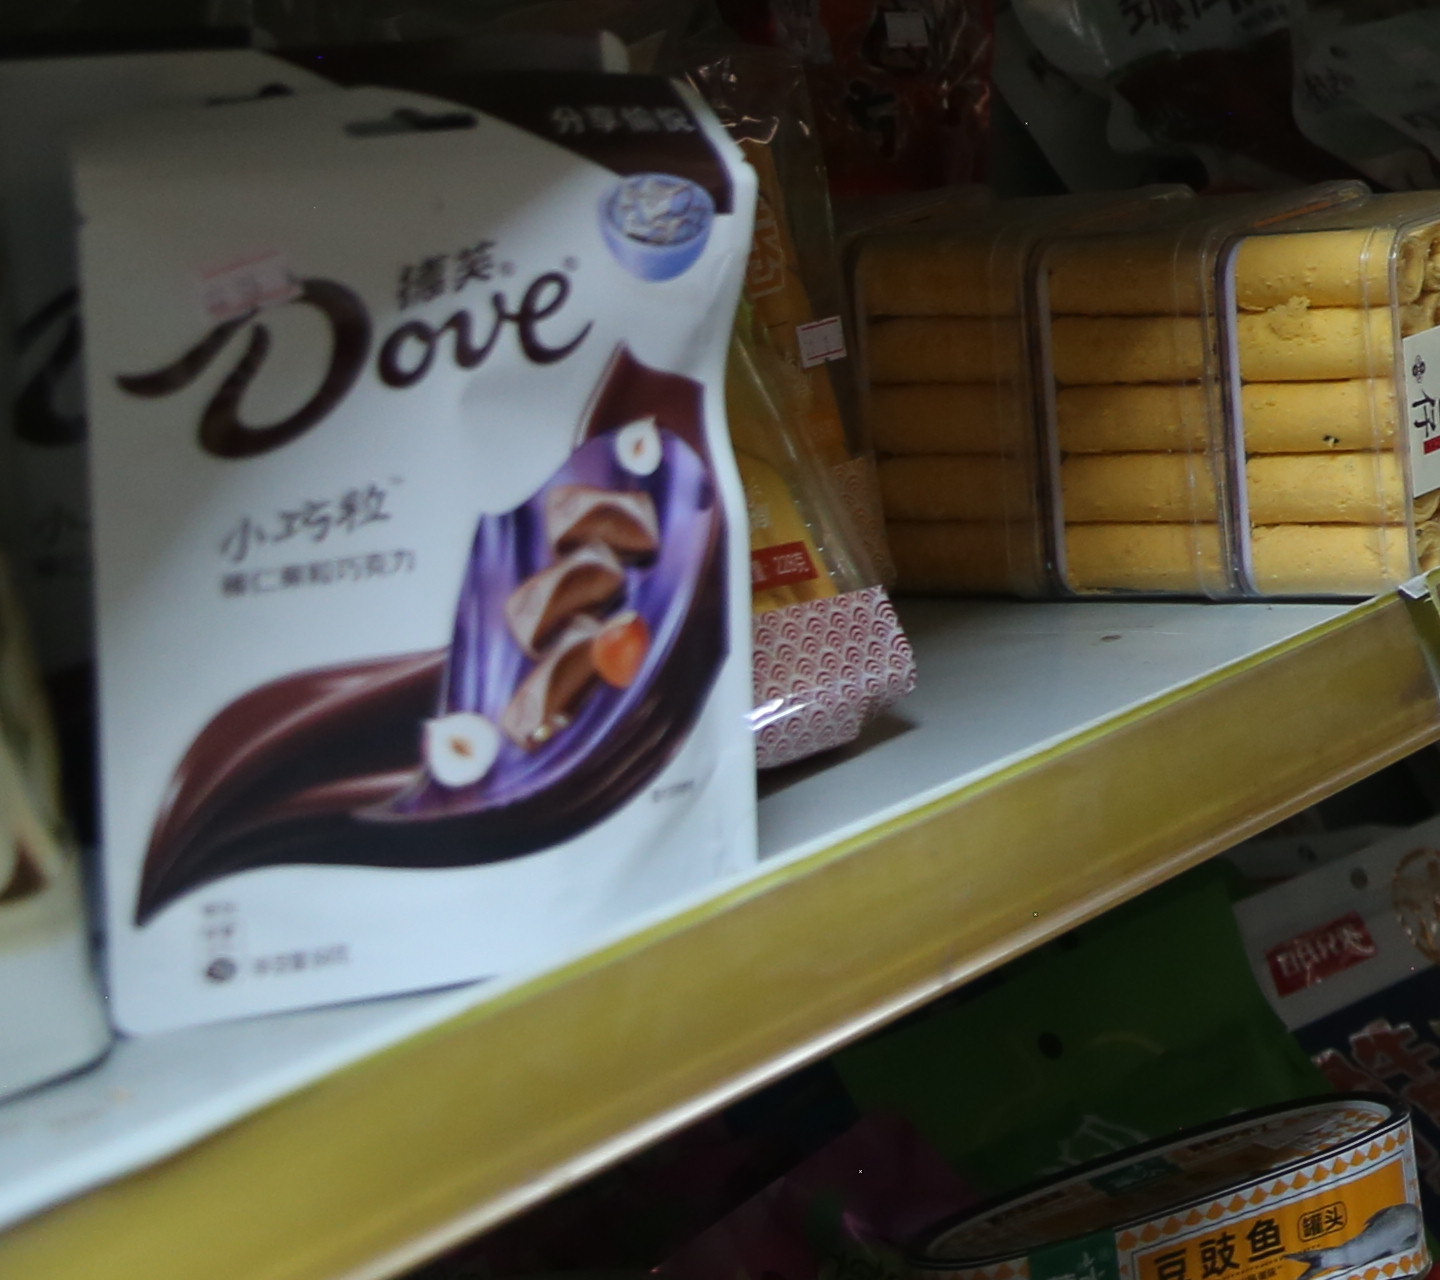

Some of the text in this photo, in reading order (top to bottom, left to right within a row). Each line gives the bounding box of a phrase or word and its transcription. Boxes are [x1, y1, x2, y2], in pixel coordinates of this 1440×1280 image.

[116, 268, 594, 459] Dove
[218, 481, 394, 562] 小巧粒
[1155, 1210, 1287, 1280] 豆豉鱼
[1300, 1206, 1343, 1238] 罐头
